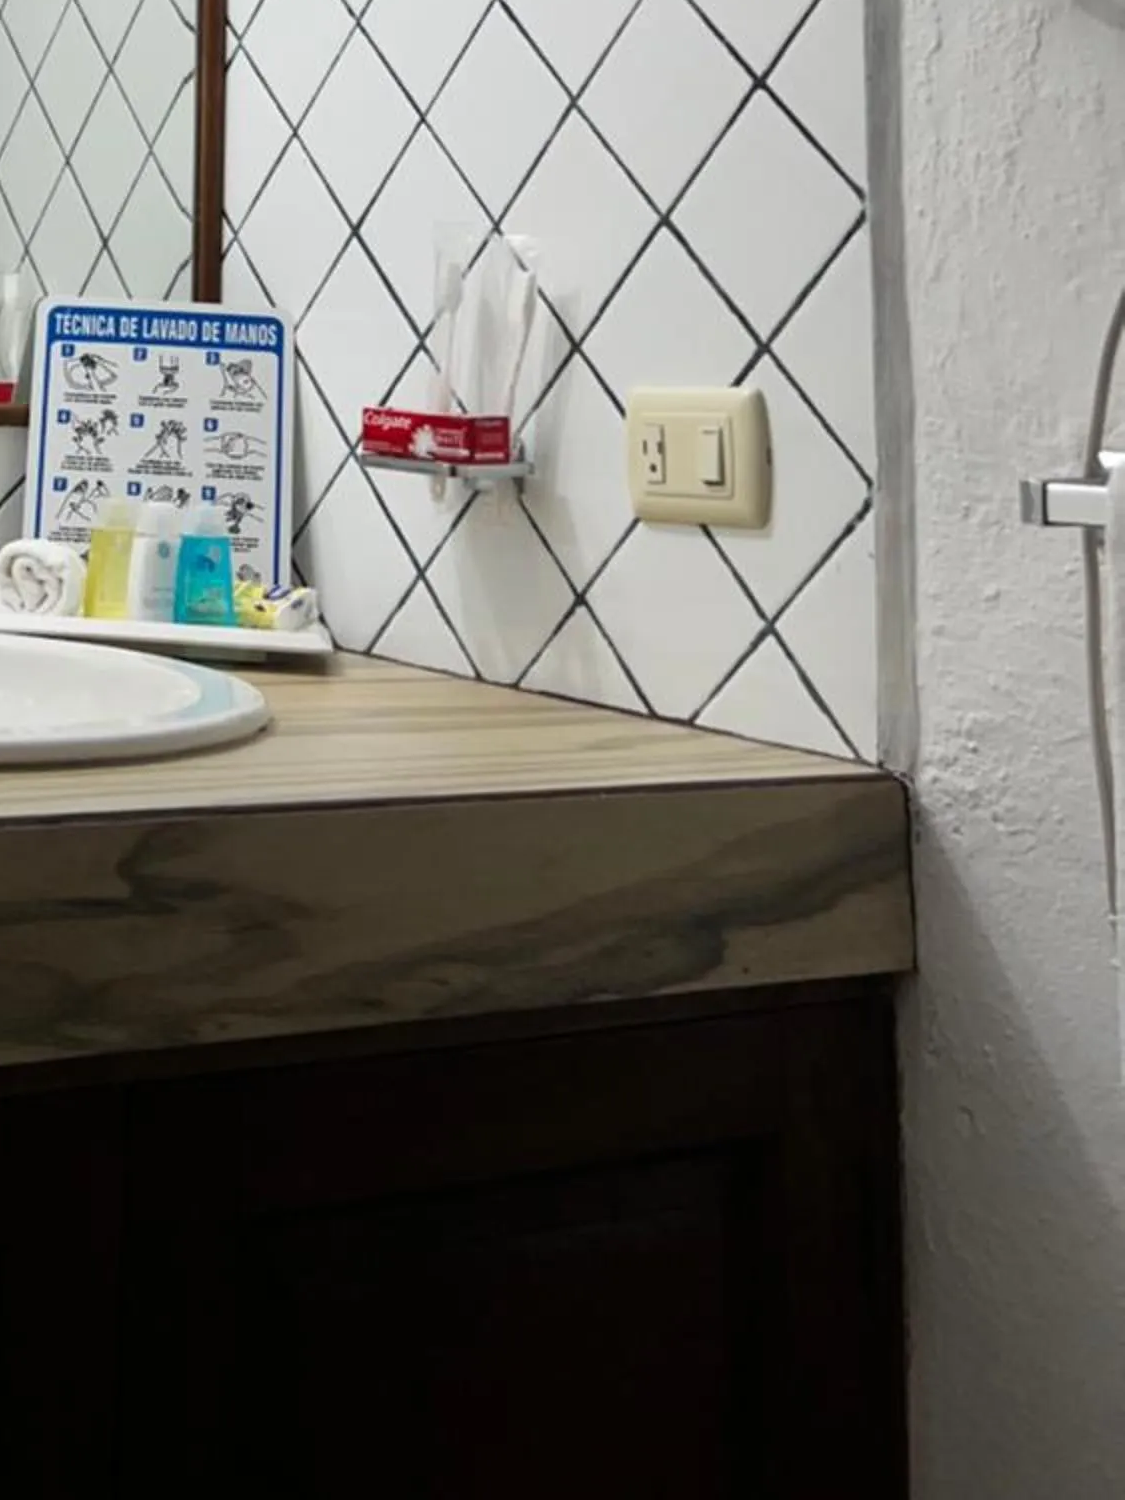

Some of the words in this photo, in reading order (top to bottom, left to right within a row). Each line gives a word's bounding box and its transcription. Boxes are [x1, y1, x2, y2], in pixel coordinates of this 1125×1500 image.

[55, 308, 115, 337] TÉCNICA
[120, 316, 139, 338] DE
[142, 316, 197, 342] LAVADO
[201, 320, 221, 343] DE
[225, 322, 277, 346] MANOS
[364, 411, 412, 431] Colgate
